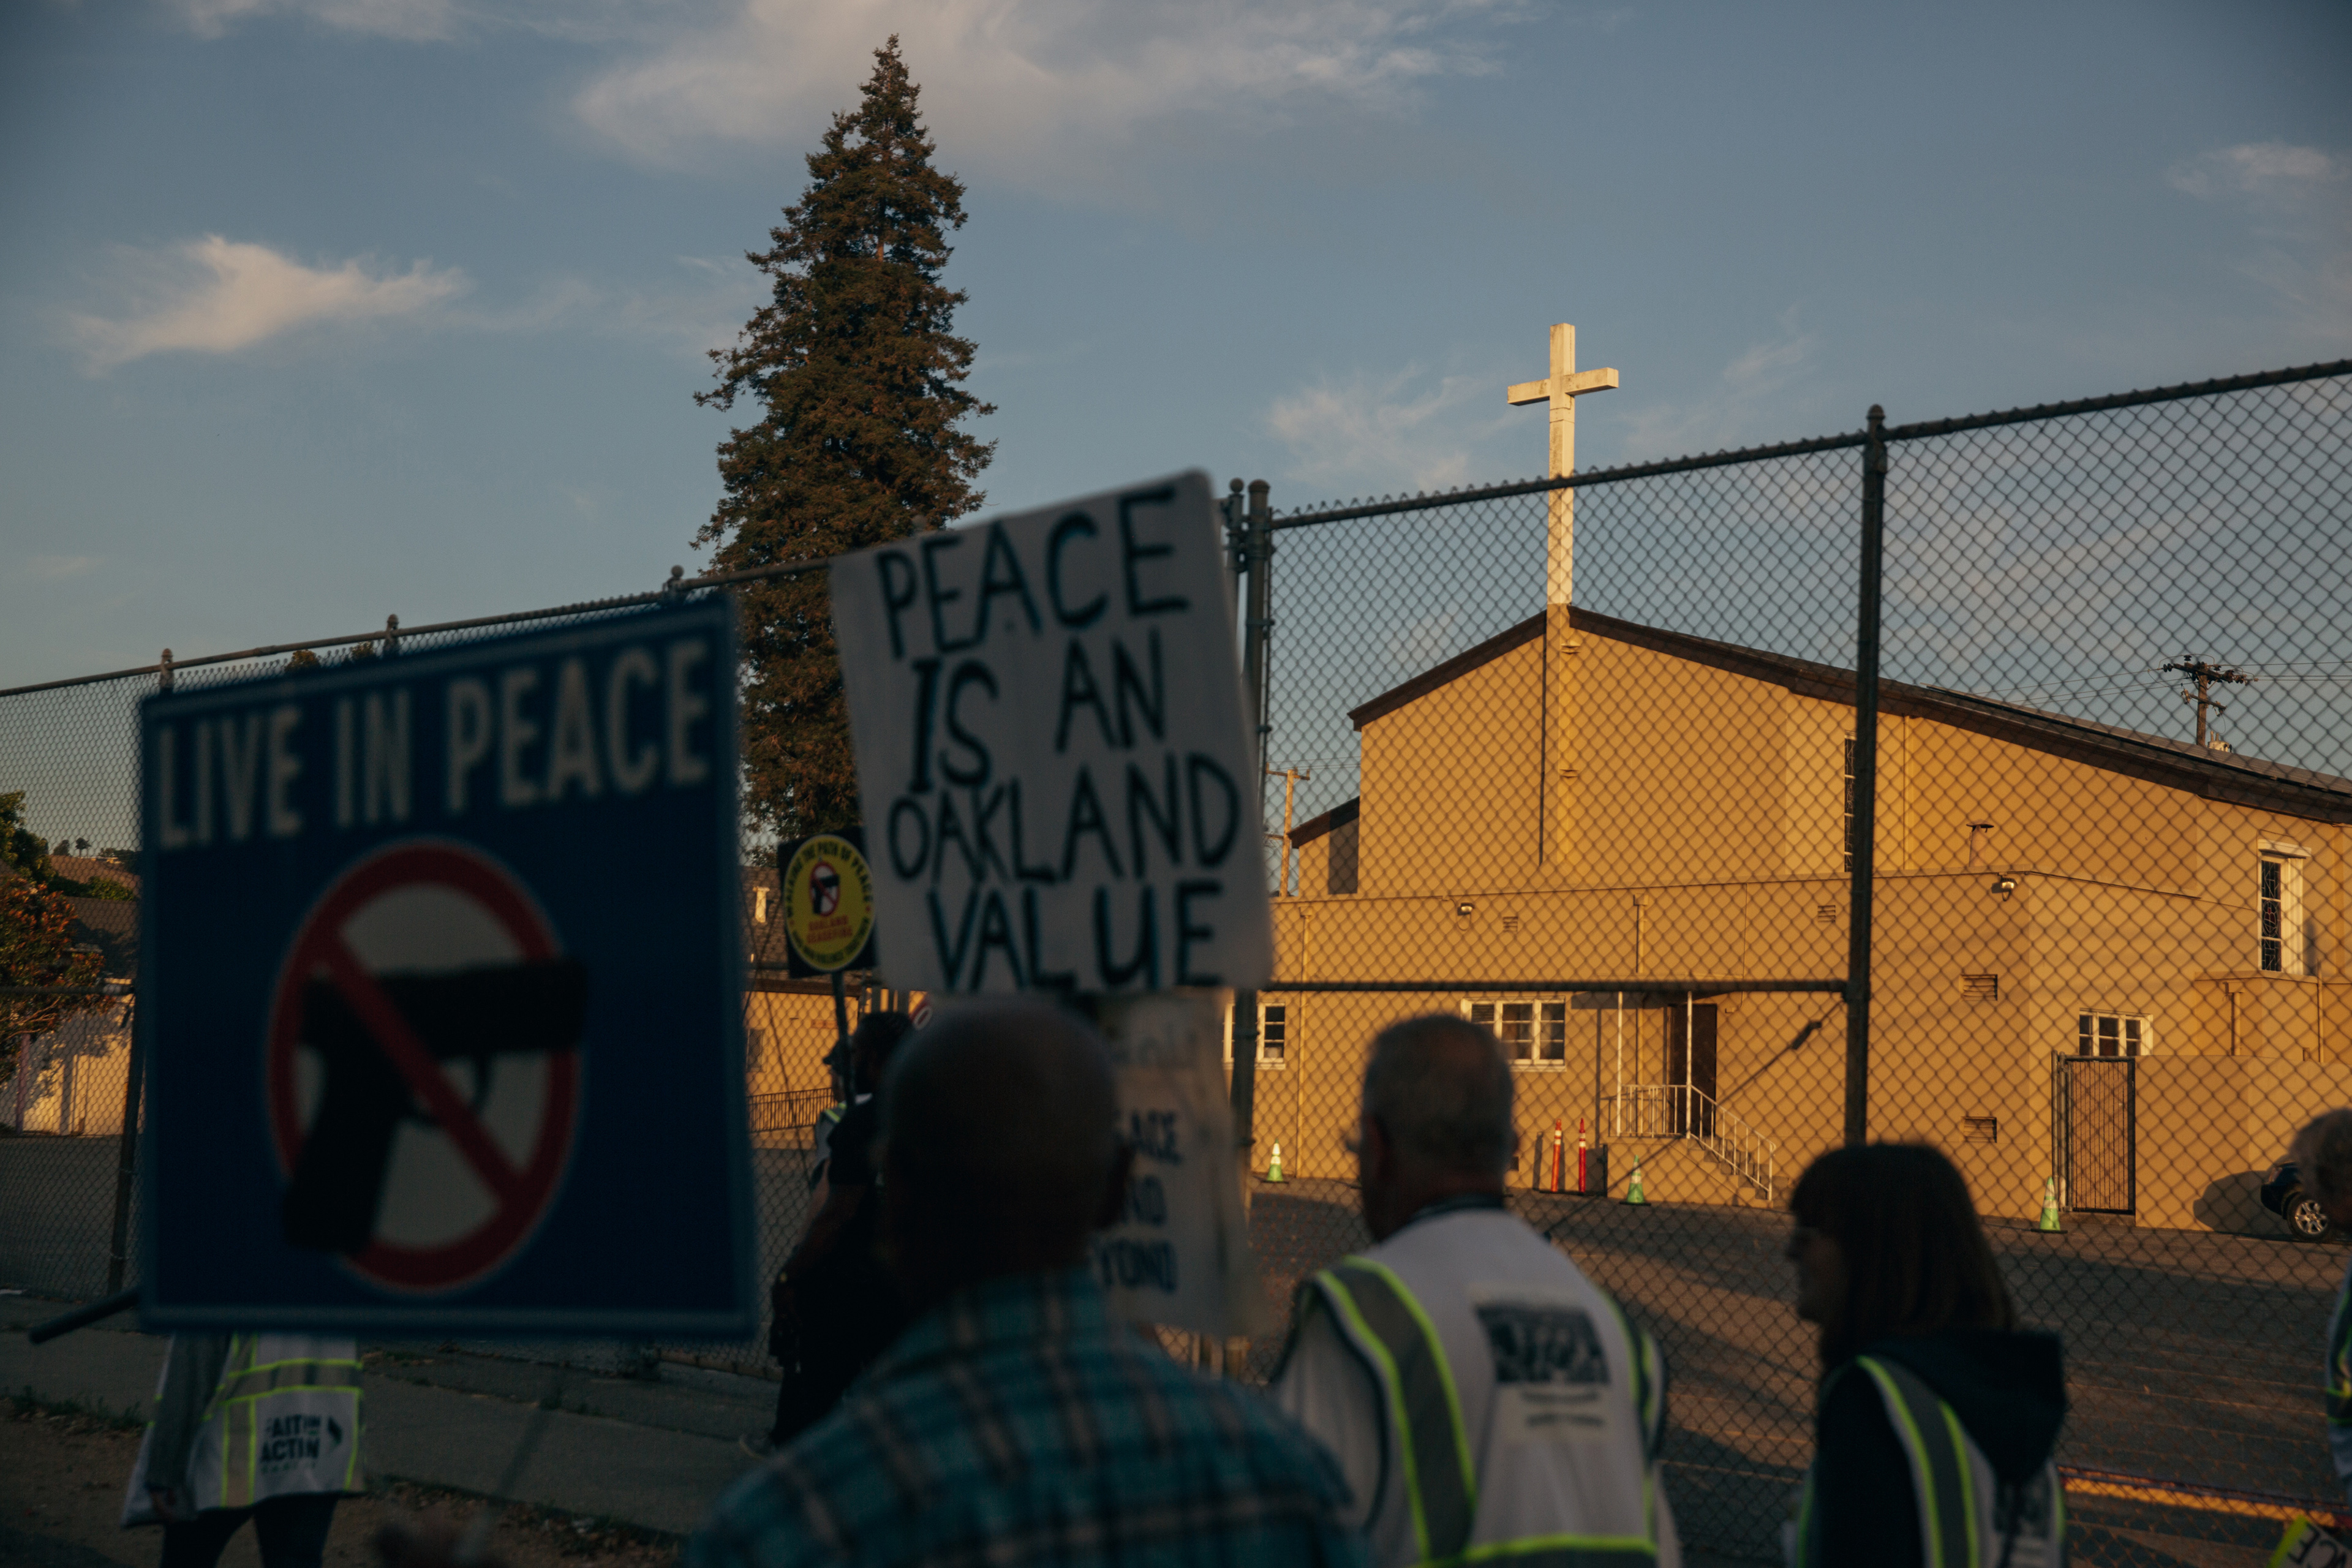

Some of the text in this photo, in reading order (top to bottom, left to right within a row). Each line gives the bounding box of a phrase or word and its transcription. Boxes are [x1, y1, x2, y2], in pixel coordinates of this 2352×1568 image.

[875, 488, 1188, 658] PEACE
[158, 638, 710, 850] LIVE IN PEACE
[912, 627, 1164, 793] IS AN
[888, 753, 1239, 884] OAKLAND
[928, 880, 1223, 991] VALUE
